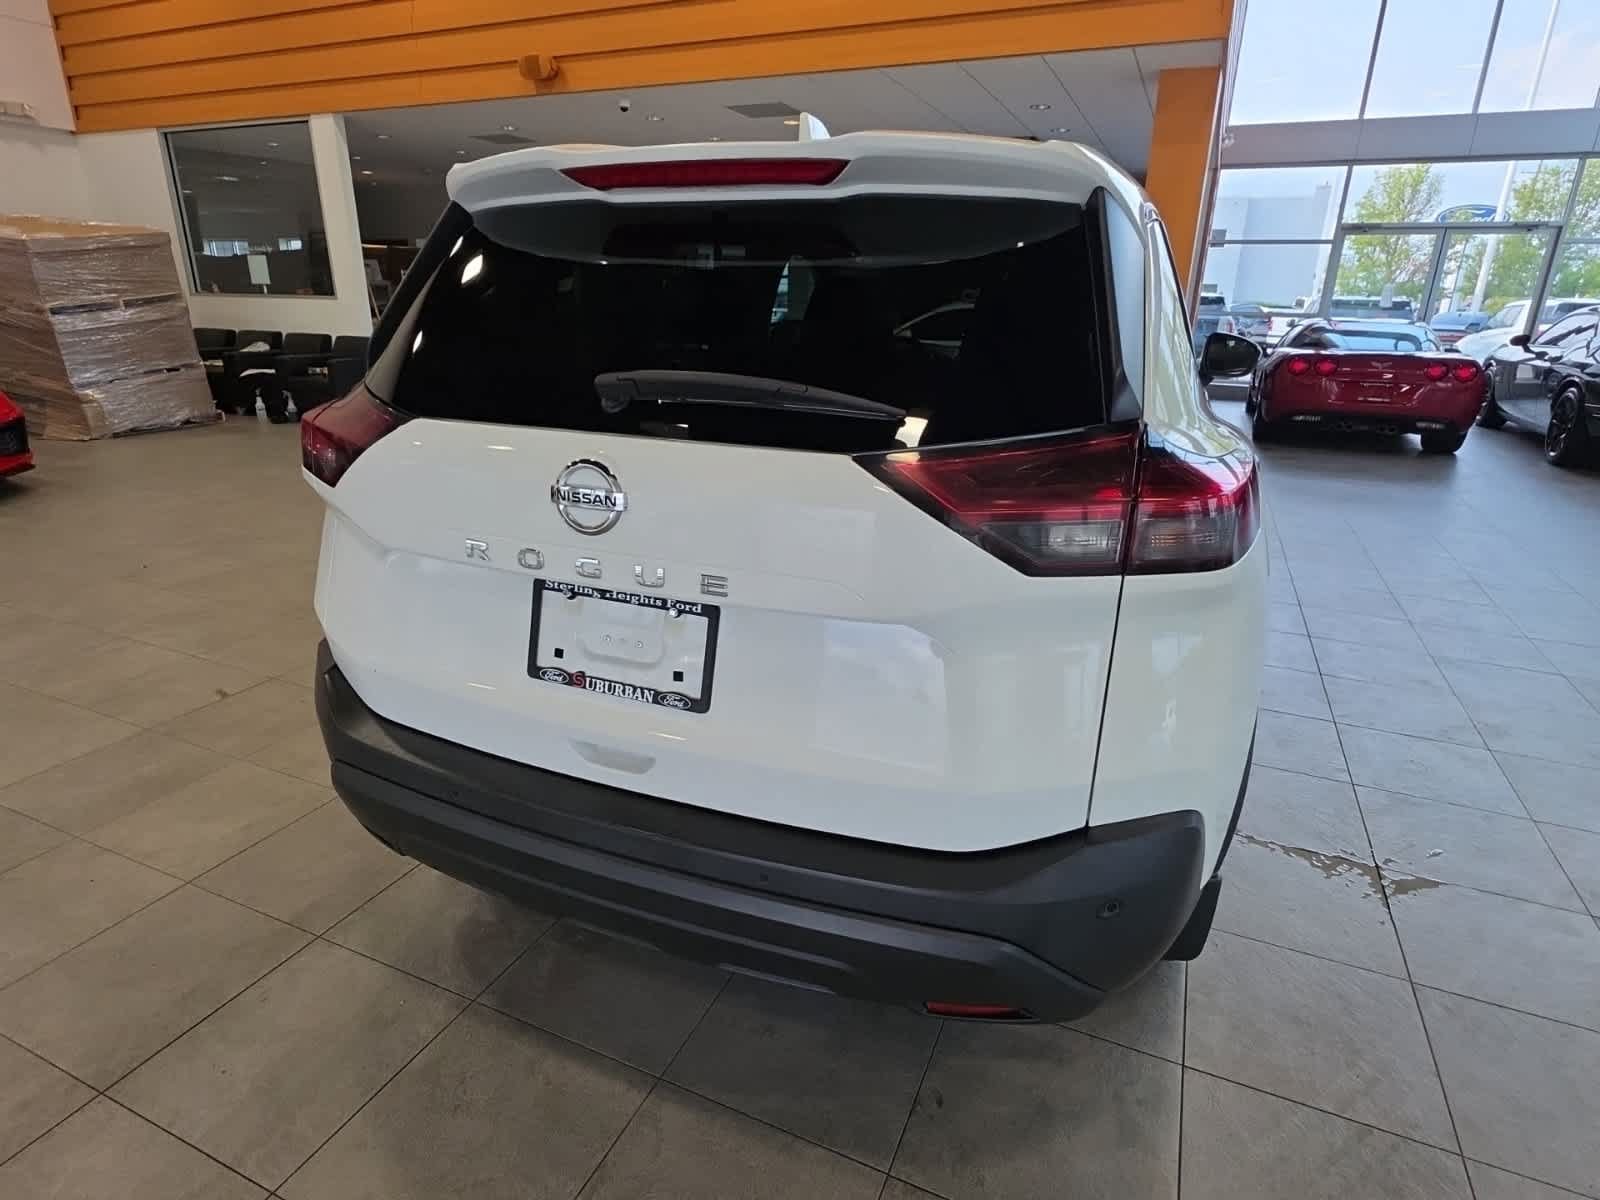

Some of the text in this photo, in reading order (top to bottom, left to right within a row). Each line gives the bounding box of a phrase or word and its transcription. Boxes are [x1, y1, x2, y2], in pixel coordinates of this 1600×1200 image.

[557, 489, 617, 507] NISSAN
[465, 537, 729, 598] ROGUE
[545, 579, 601, 598] Sterling
[666, 599, 702, 613] Ford
[542, 669, 567, 683] Ford
[573, 672, 655, 704] SUBURBAN
[661, 694, 688, 708] Ford
